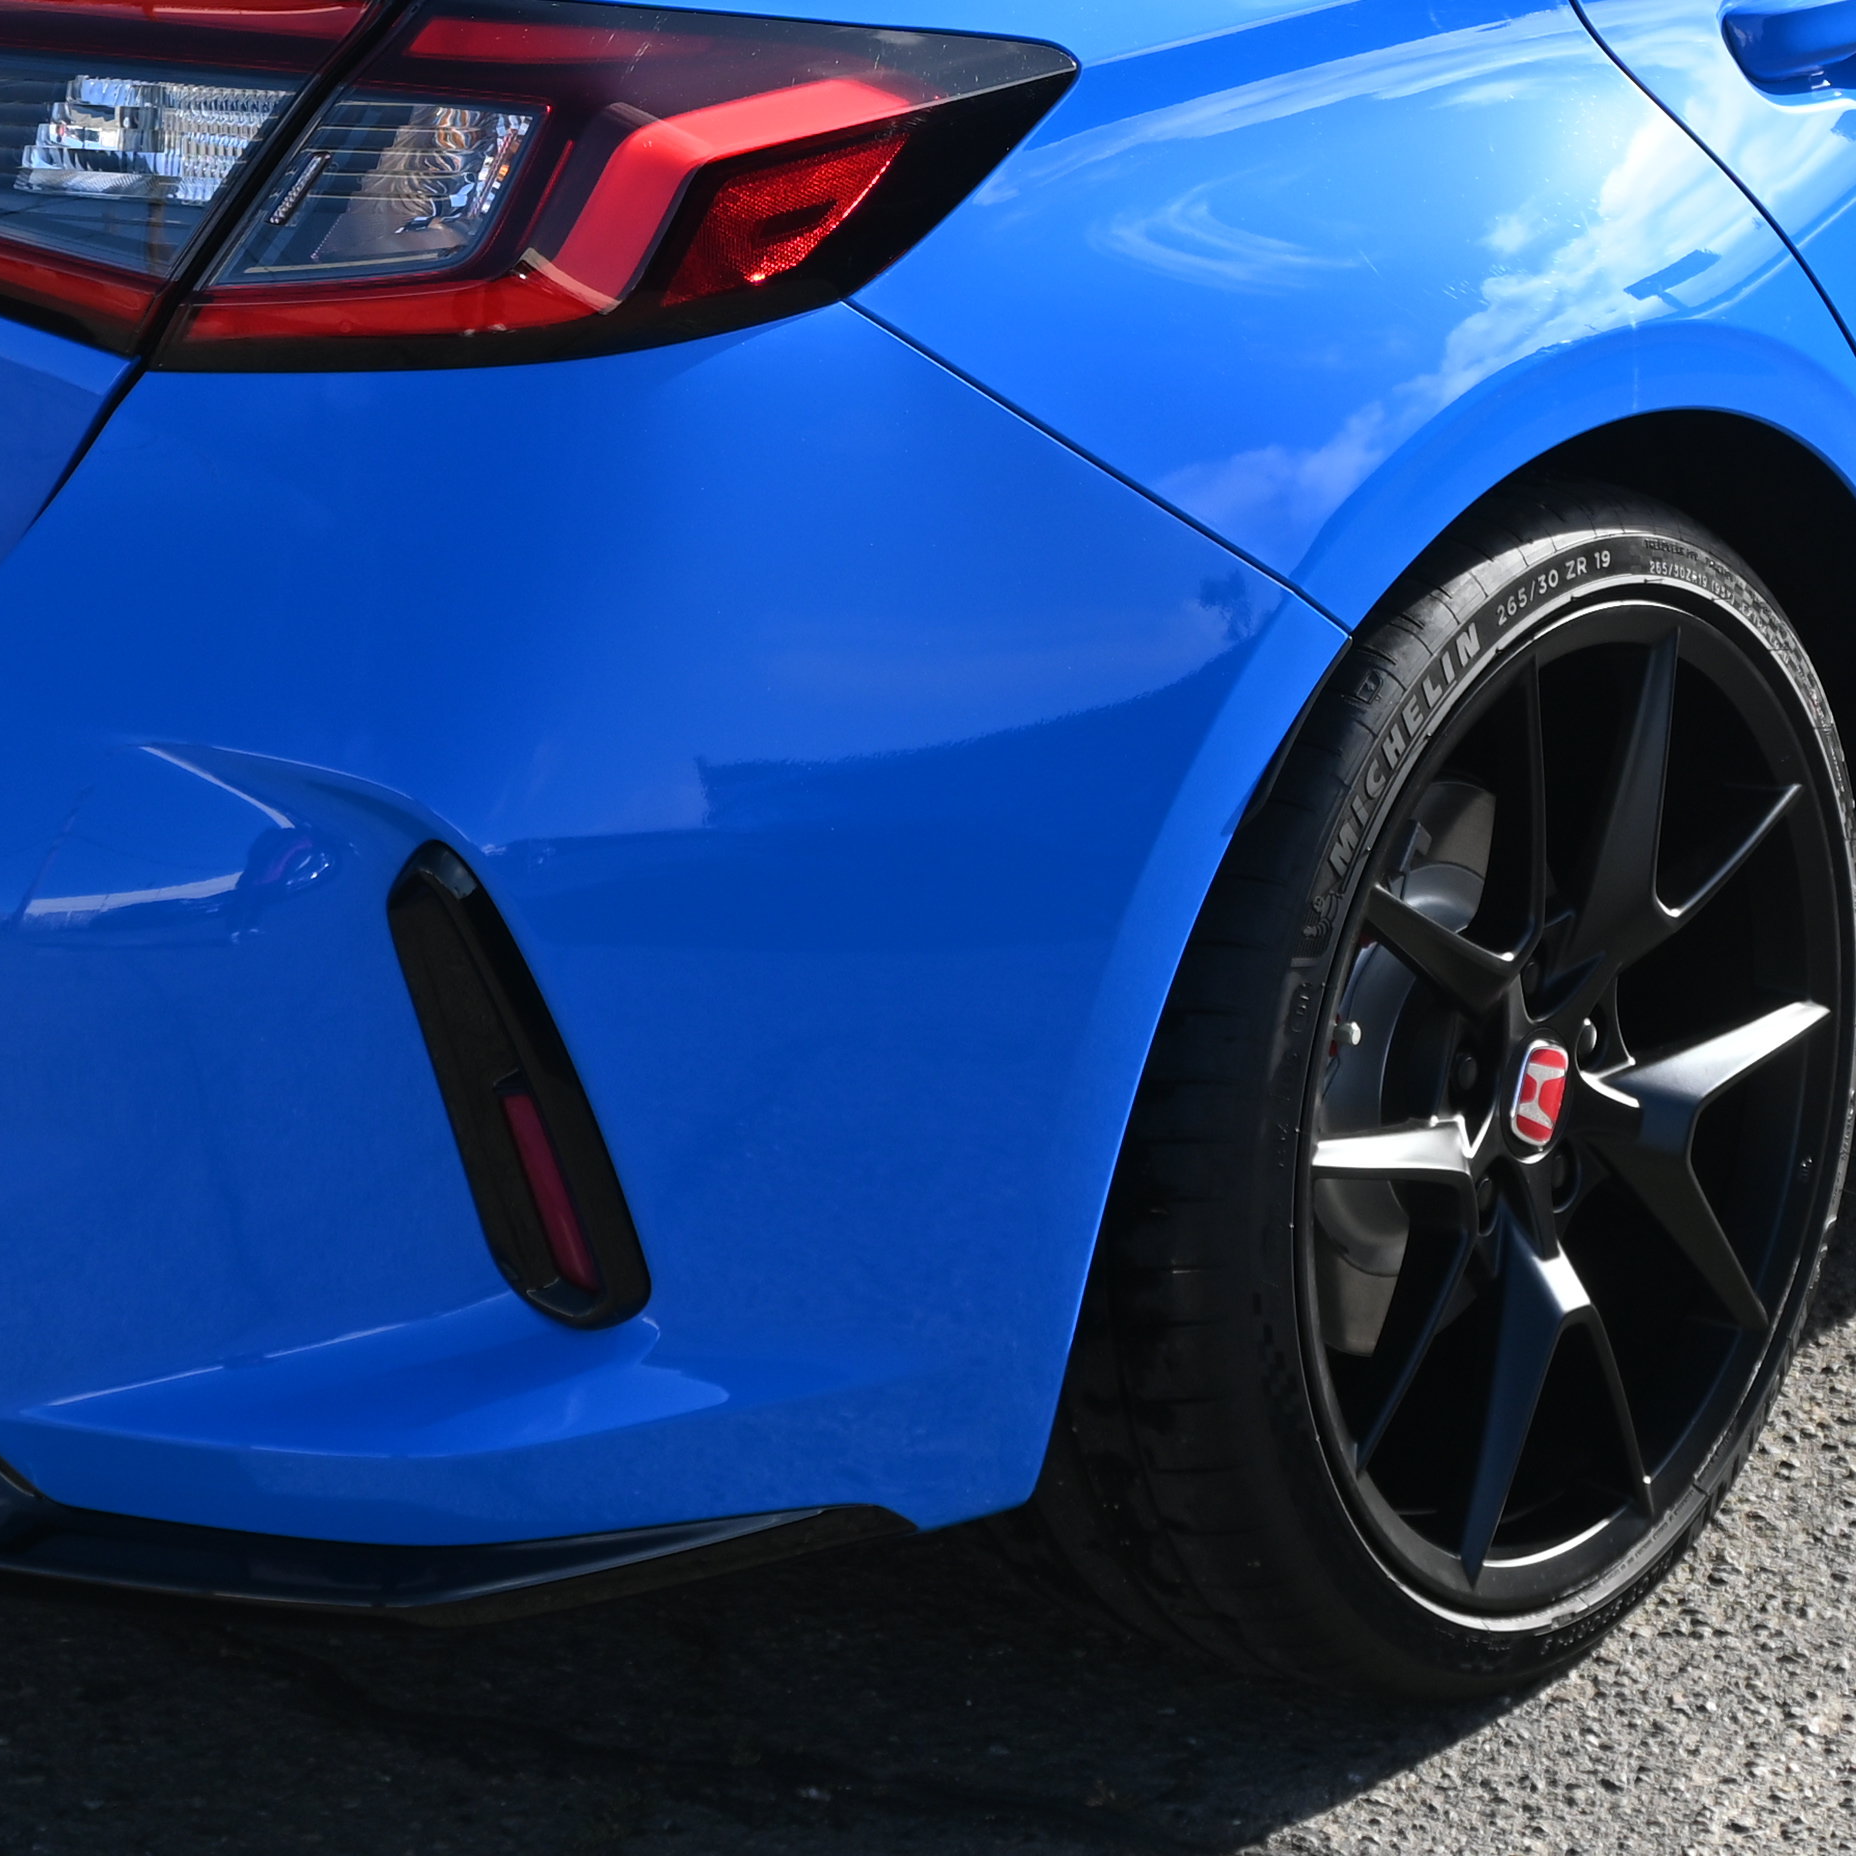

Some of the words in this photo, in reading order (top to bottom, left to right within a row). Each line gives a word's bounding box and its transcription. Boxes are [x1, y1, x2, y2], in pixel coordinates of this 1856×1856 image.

[1496, 568, 1560, 627] 265/30
[1565, 556, 1588, 581] ZR
[1594, 550, 1612, 569] 19
[1328, 622, 1481, 876] MICHELIN
